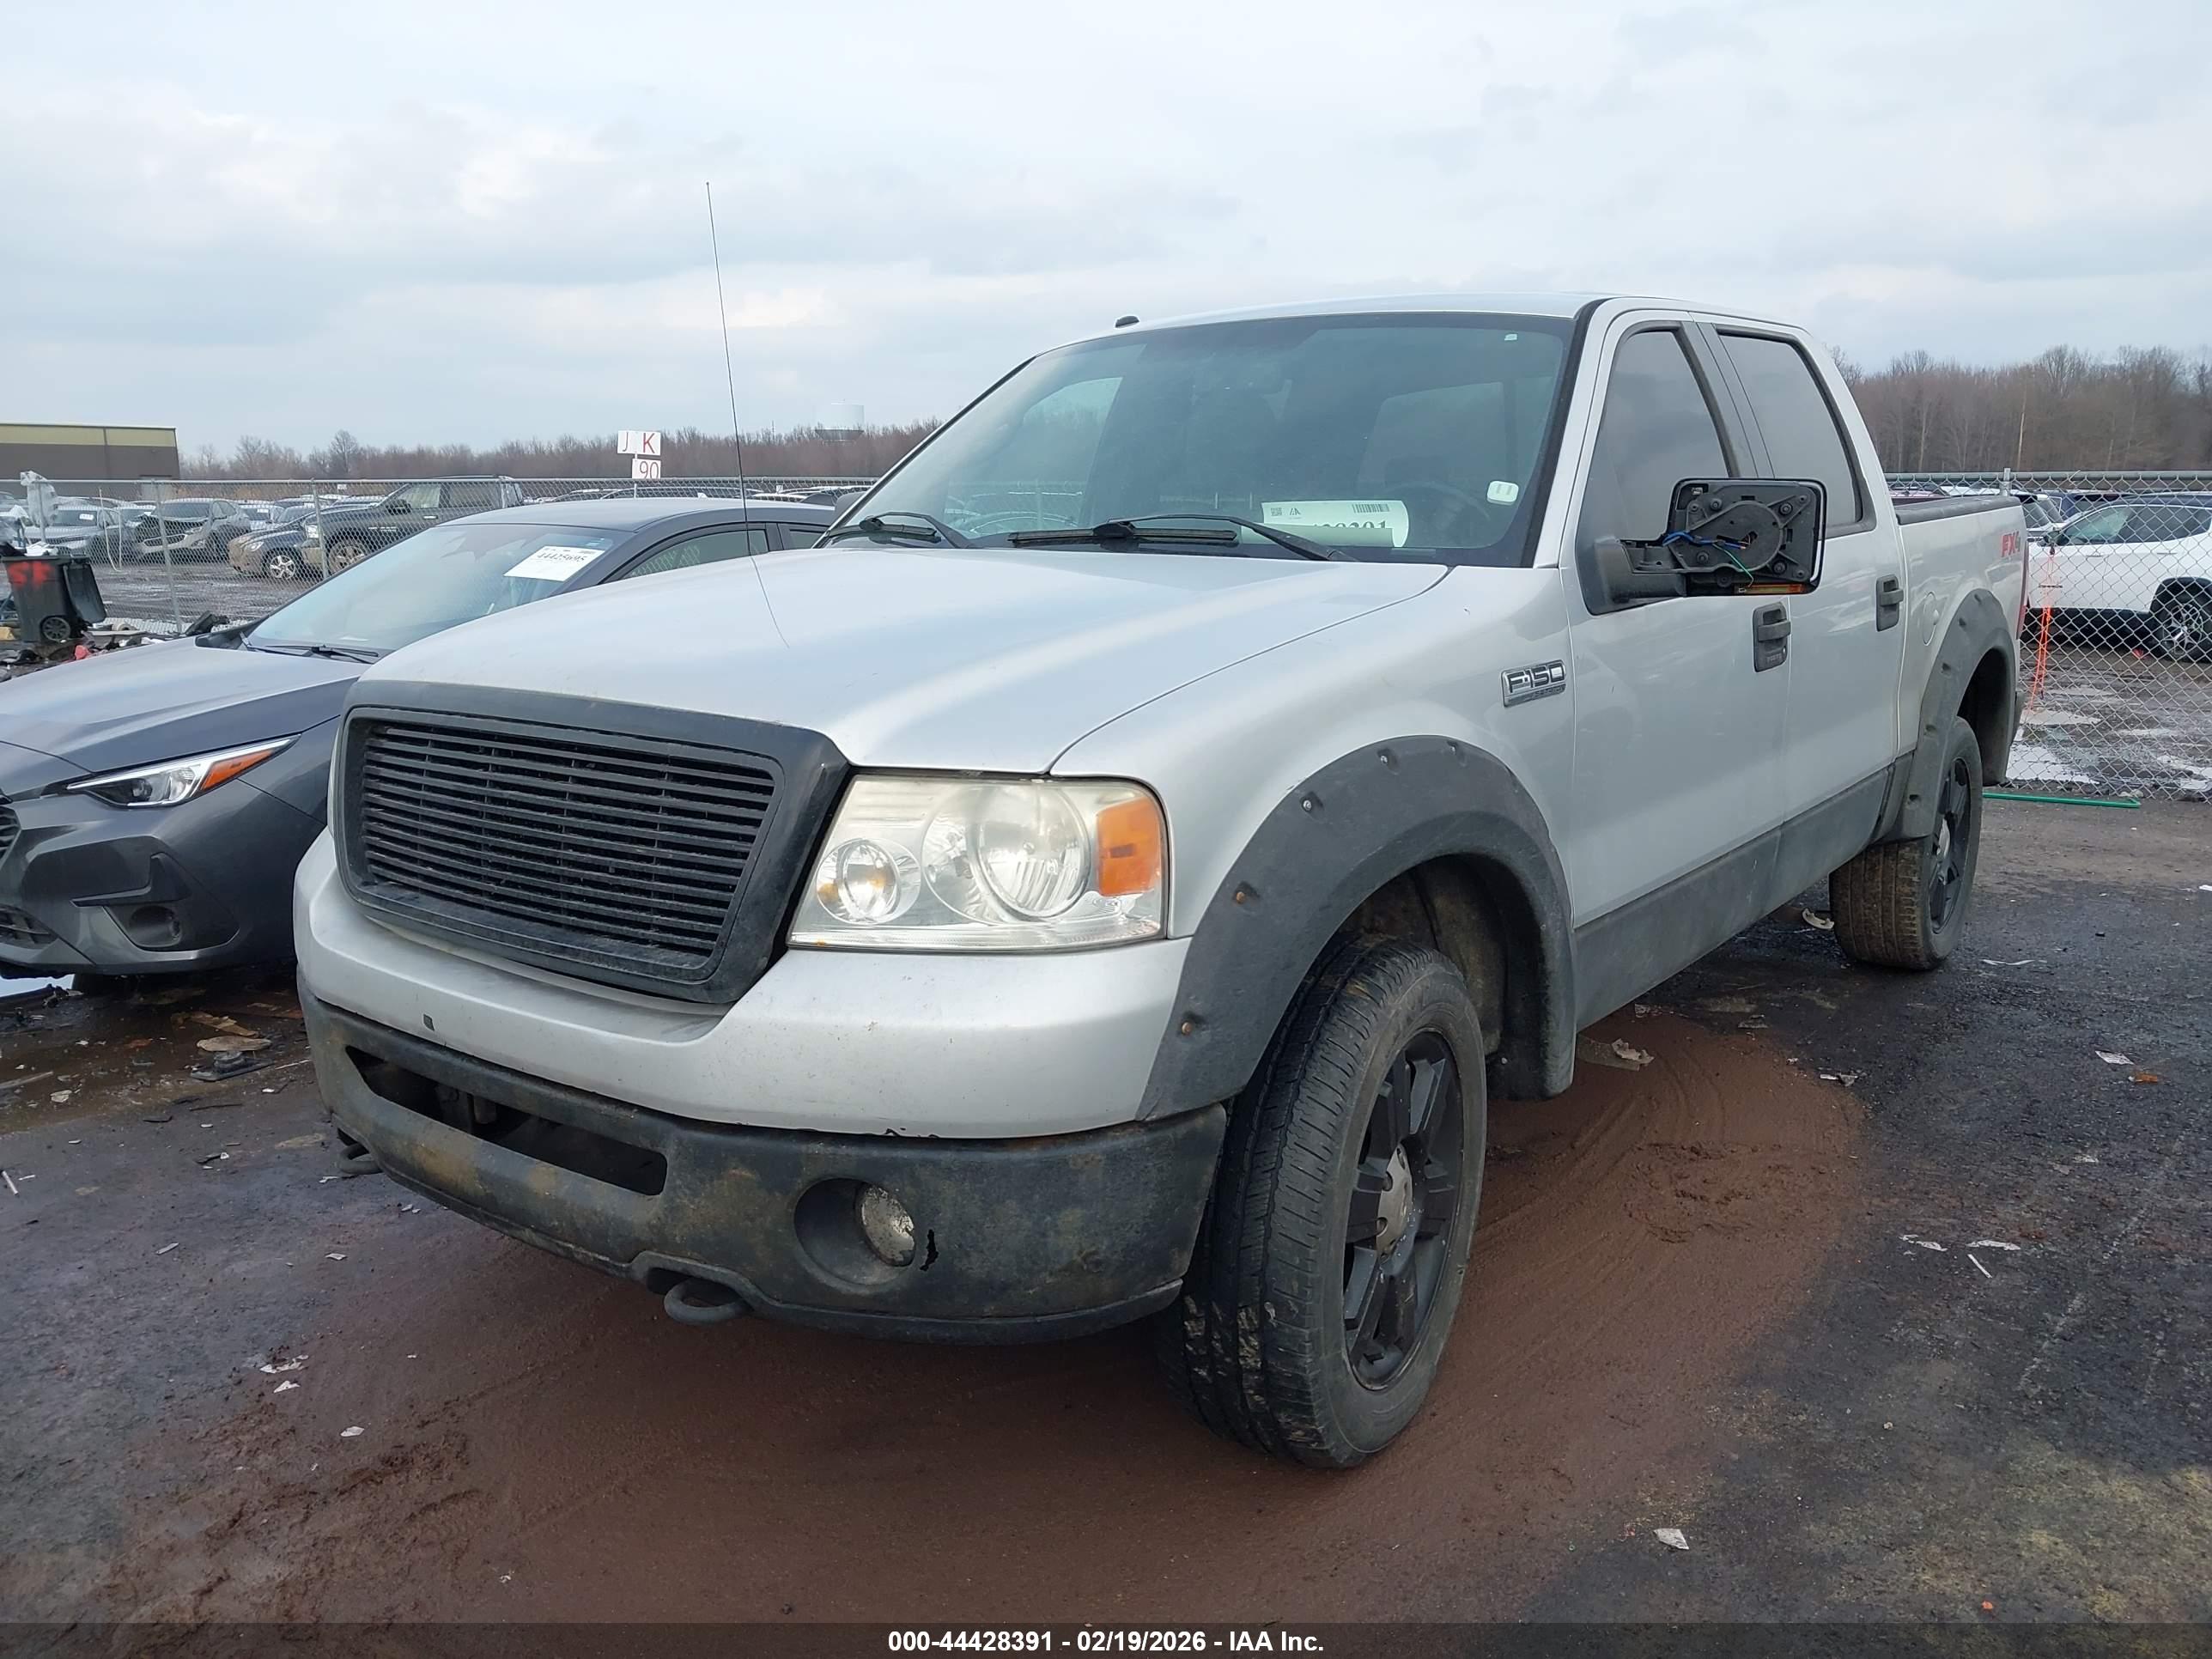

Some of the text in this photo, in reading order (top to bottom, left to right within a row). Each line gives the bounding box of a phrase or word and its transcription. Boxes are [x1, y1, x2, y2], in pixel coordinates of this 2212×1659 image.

[622, 432, 655, 453] J K
[639, 460, 659, 479] 90
